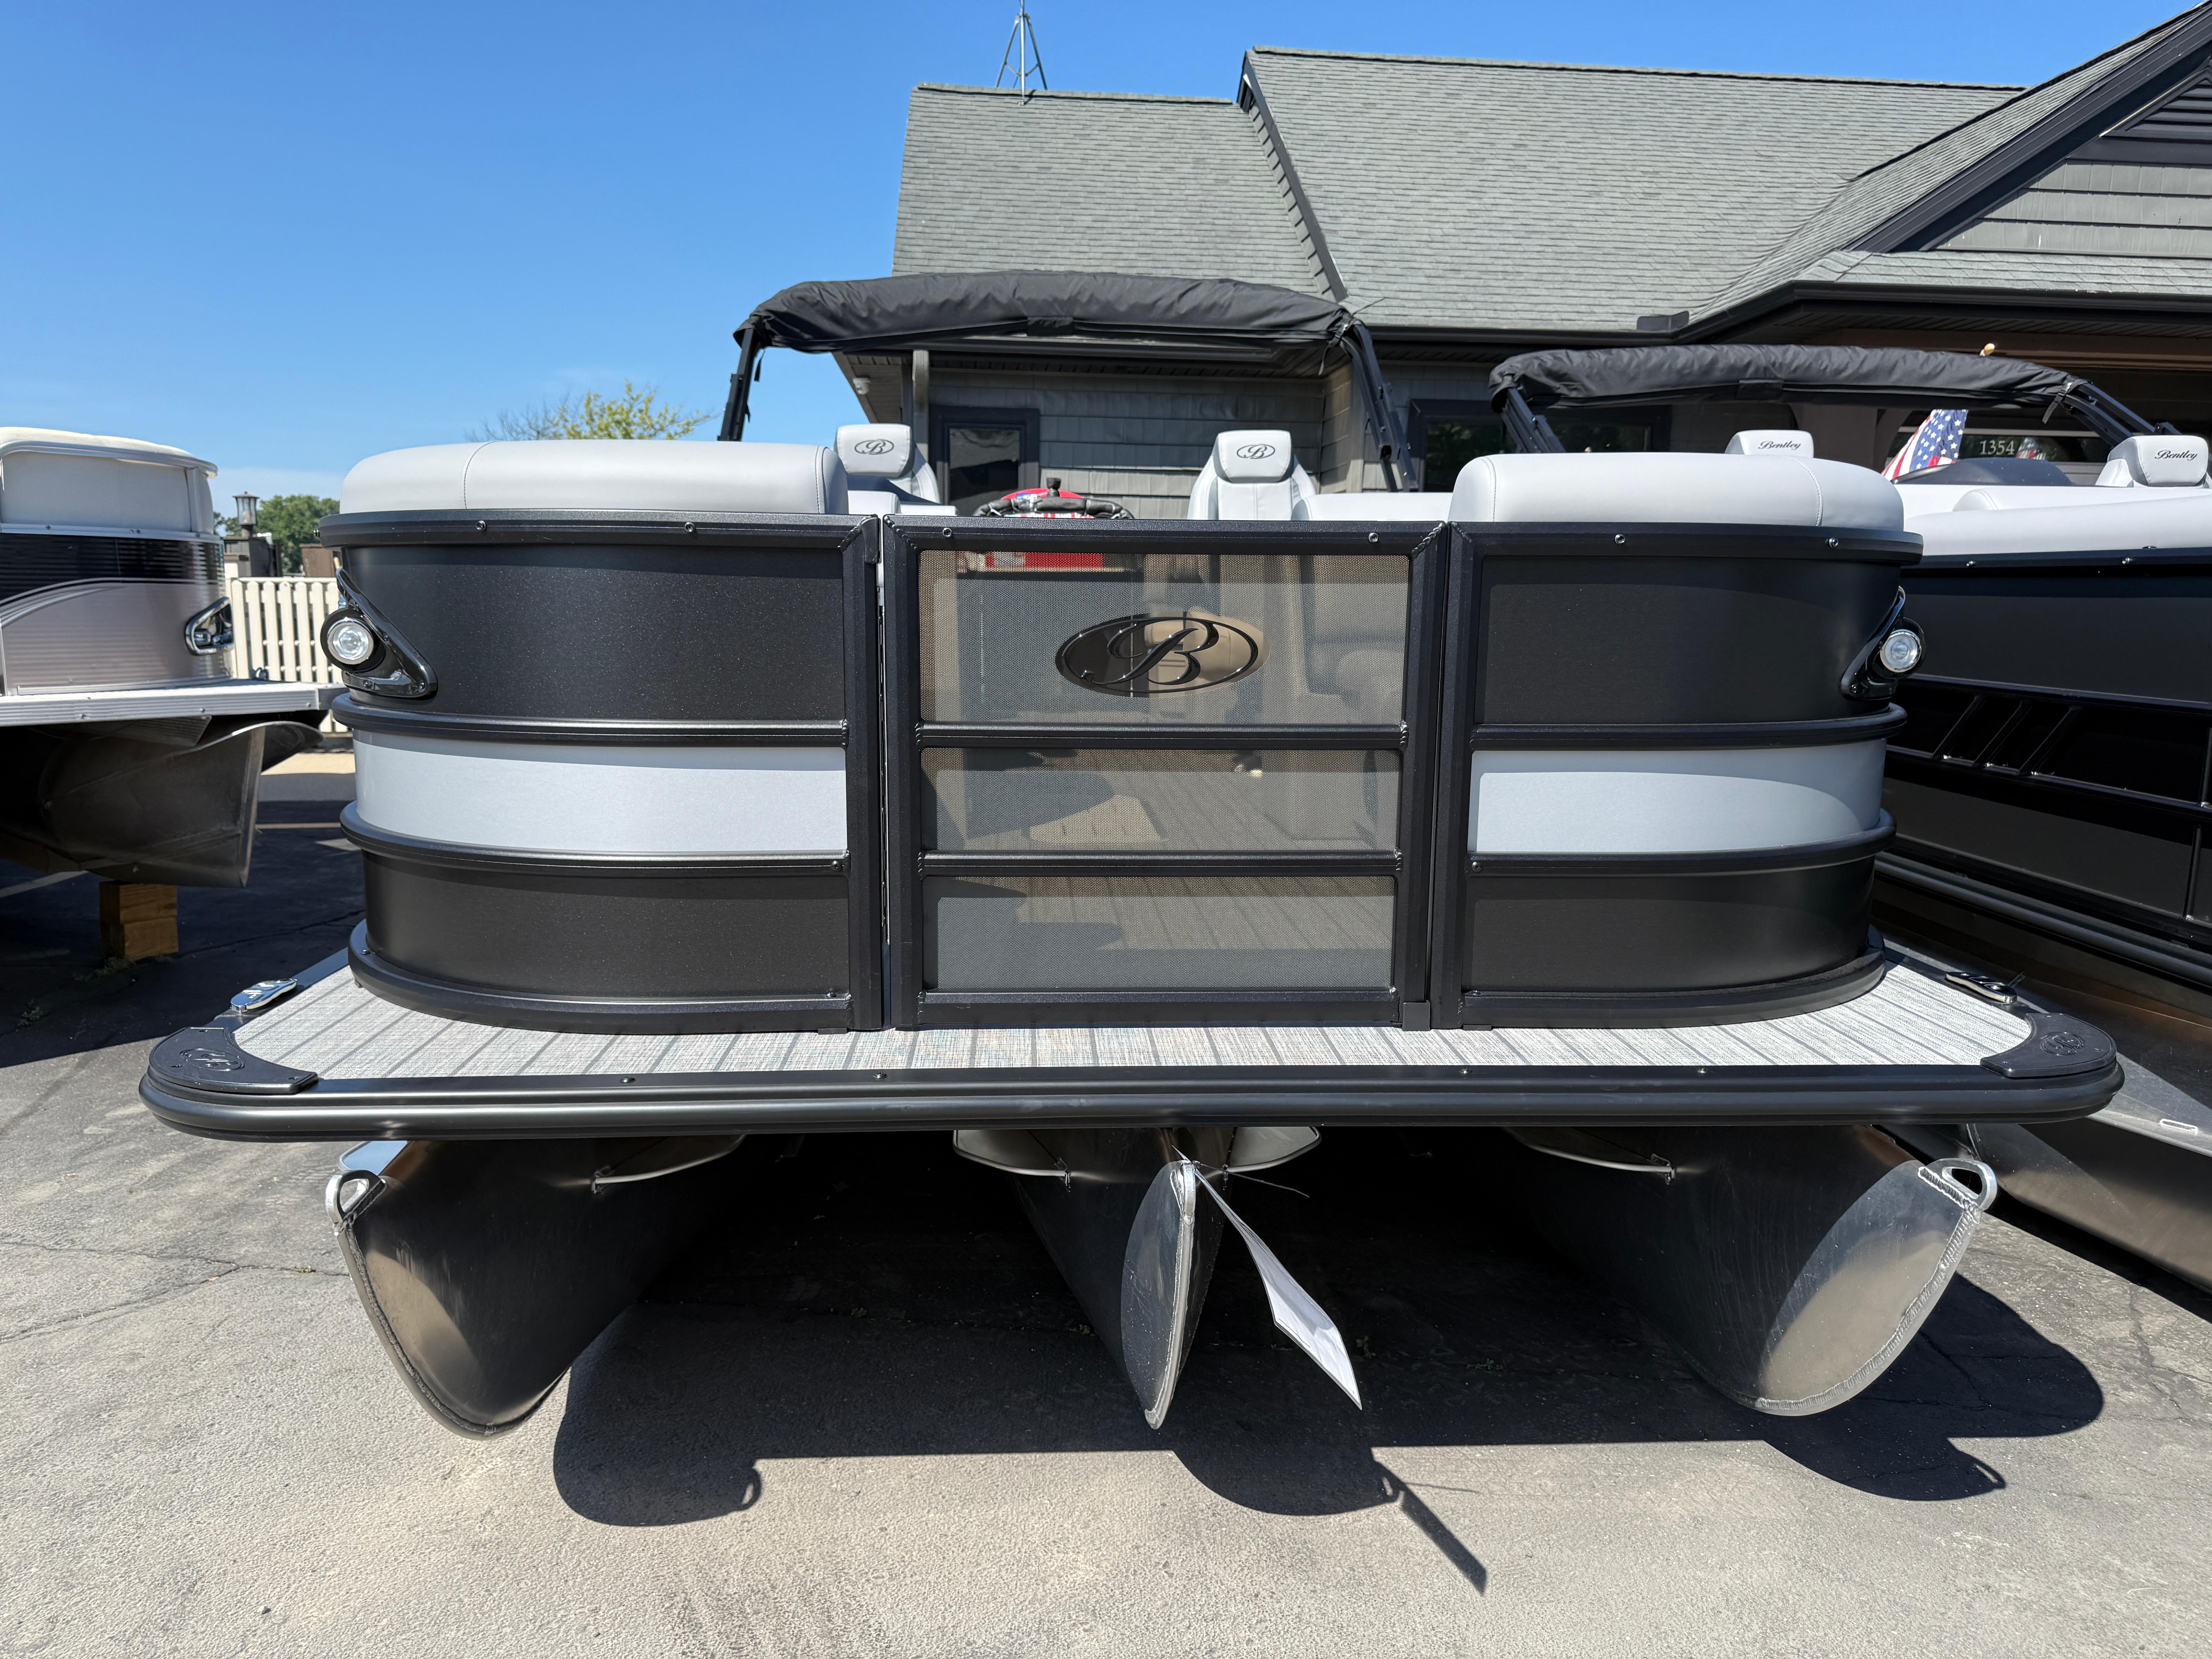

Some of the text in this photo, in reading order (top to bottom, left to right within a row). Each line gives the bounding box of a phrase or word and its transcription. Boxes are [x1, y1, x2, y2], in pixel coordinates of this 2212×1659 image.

[1758, 440, 1801, 450] Bentley
[1980, 440, 2015, 455] 1354
[2154, 449, 2198, 461] Bentley
